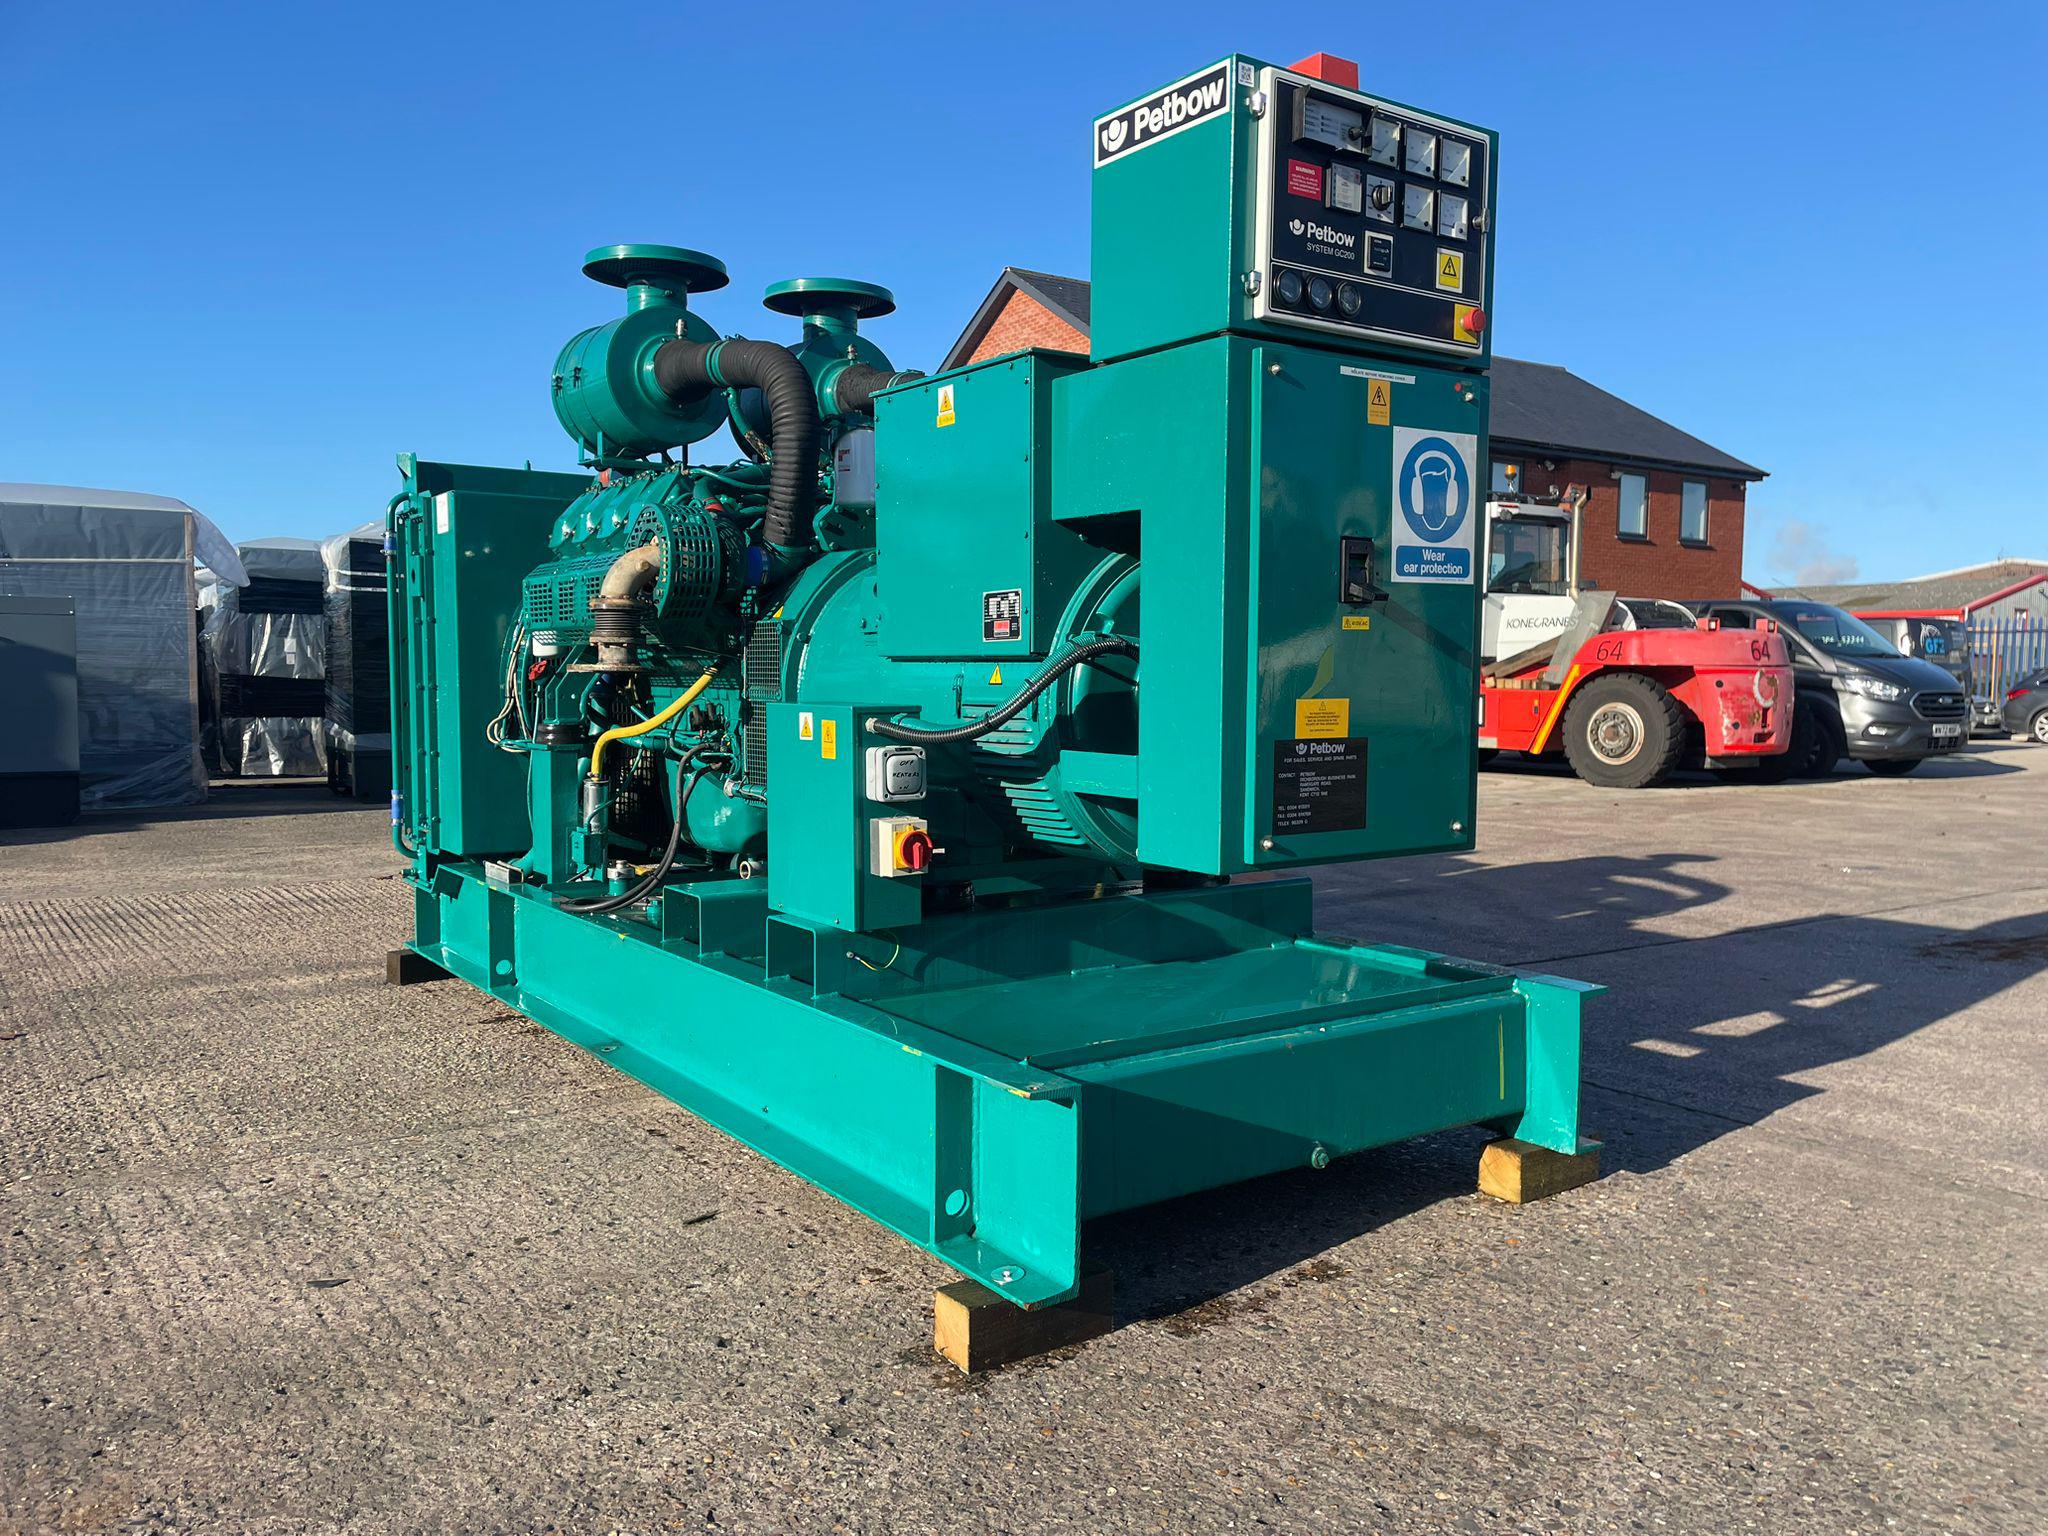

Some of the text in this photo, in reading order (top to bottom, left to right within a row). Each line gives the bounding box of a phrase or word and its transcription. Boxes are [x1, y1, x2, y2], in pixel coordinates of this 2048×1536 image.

[1134, 77, 1224, 141] Petbow
[1306, 221, 1355, 248] Petbow
[1306, 242, 1355, 260] SYSTEM GC200
[1422, 549, 1446, 562] Wear
[1403, 563, 1463, 576] ear protection
[1505, 616, 1579, 630] KONECRANES
[1596, 640, 1623, 662] 64
[1750, 640, 1771, 661] 64
[1309, 742, 1346, 755] Petbow
